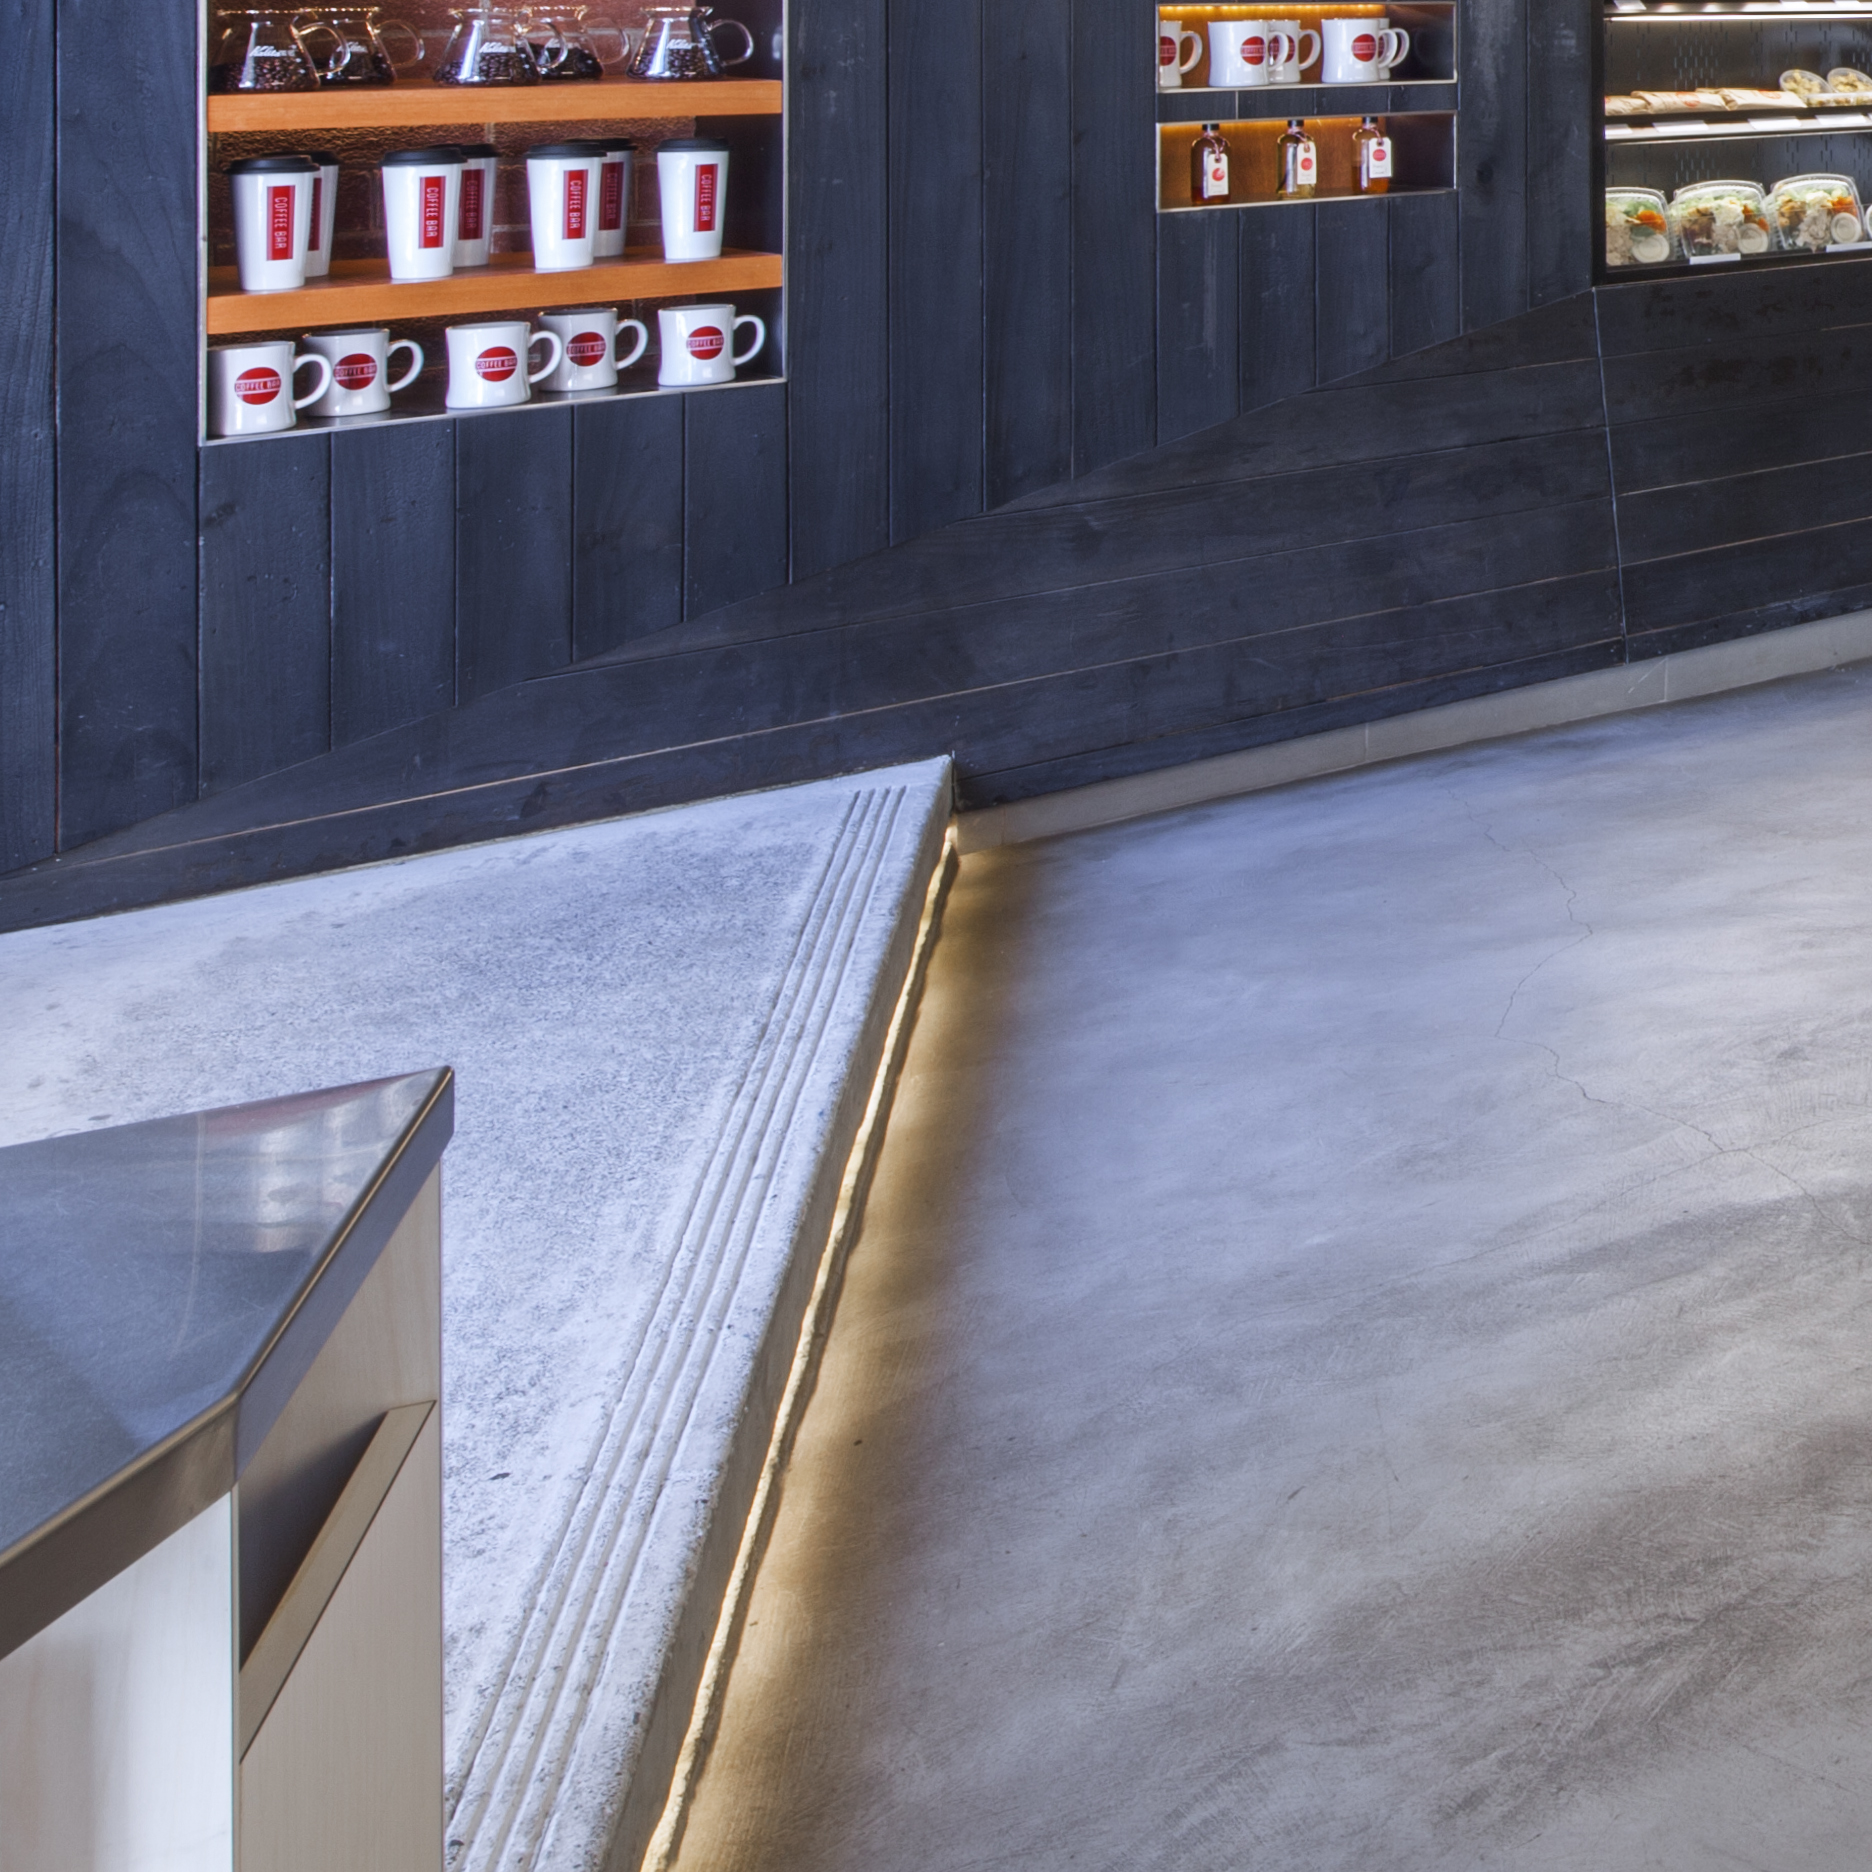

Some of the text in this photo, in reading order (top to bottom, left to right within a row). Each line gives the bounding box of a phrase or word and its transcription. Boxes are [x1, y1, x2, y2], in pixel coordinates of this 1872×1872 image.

[570, 179, 582, 210] COFFEE
[701, 173, 712, 203] COFFEE
[274, 196, 288, 228] COFFEE
[426, 187, 438, 218] COFFEE
[687, 338, 711, 349] COFFEE
[334, 367, 361, 378] COFFEE
[476, 359, 502, 371] COFFEE
[235, 380, 264, 392] COFFEE
